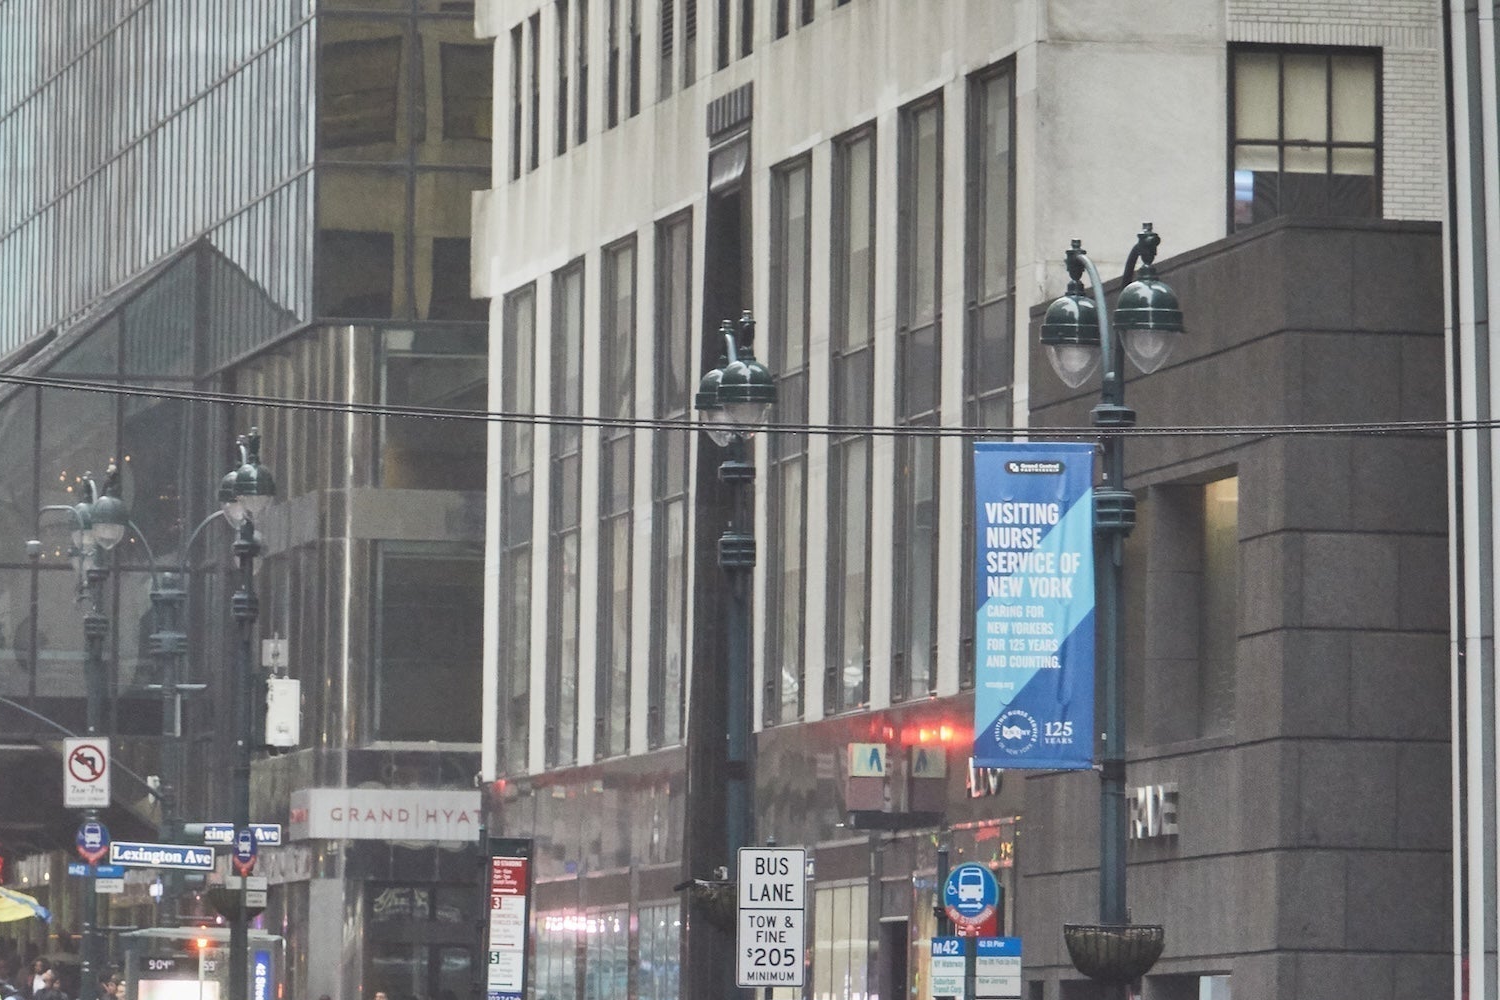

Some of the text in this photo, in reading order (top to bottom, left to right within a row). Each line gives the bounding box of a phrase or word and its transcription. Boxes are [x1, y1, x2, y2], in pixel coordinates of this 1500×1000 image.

[985, 502, 1059, 525] VISITING
[986, 527, 1042, 549] NURSE
[986, 551, 1081, 574] SERVICE OF
[987, 576, 1073, 598] NEW YORK
[987, 605, 1044, 618] CARING FOR
[987, 622, 1054, 635] NEW YORKERS
[986, 638, 1058, 652] FOR 125 YEARS
[986, 655, 1061, 669] AND COUNTING.
[1044, 721, 1073, 737] 125
[330, 807, 410, 823] GRAND
[254, 827, 279, 842] Ave
[113, 846, 212, 865] Lexington Ave
[755, 857, 789, 875] BUS
[749, 883, 794, 902] LANE
[493, 897, 500, 909] 3
[748, 915, 794, 928] TOW &
[756, 931, 786, 943] FINE
[993, 940, 1005, 948] Pier
[932, 940, 959, 955] M42
[490, 951, 498, 964] 5
[747, 948, 795, 966] $205
[255, 963, 266, 975] 42
[747, 971, 795, 981] MINIMUM
